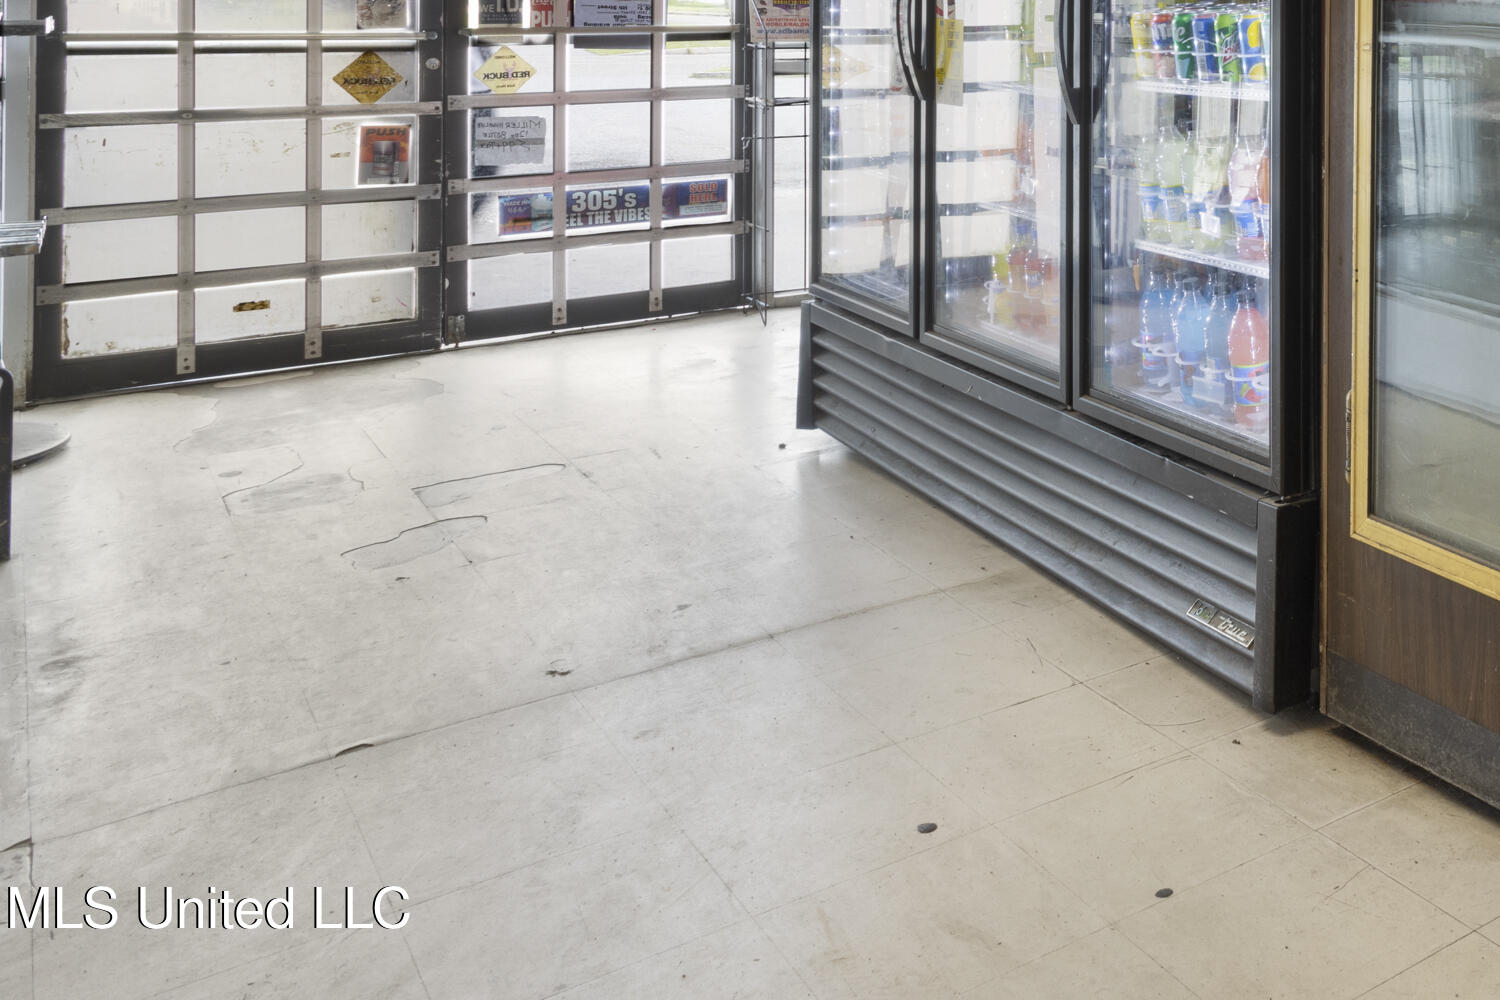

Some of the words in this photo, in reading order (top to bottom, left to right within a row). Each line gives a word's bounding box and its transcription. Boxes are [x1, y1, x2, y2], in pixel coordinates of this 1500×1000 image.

[480, 4, 495, 12] WE
[365, 128, 407, 137] PUSH
[689, 182, 718, 193] SOLD
[571, 188, 637, 212] 305's
[587, 211, 611, 226] THE
[613, 207, 650, 224] VIBES
